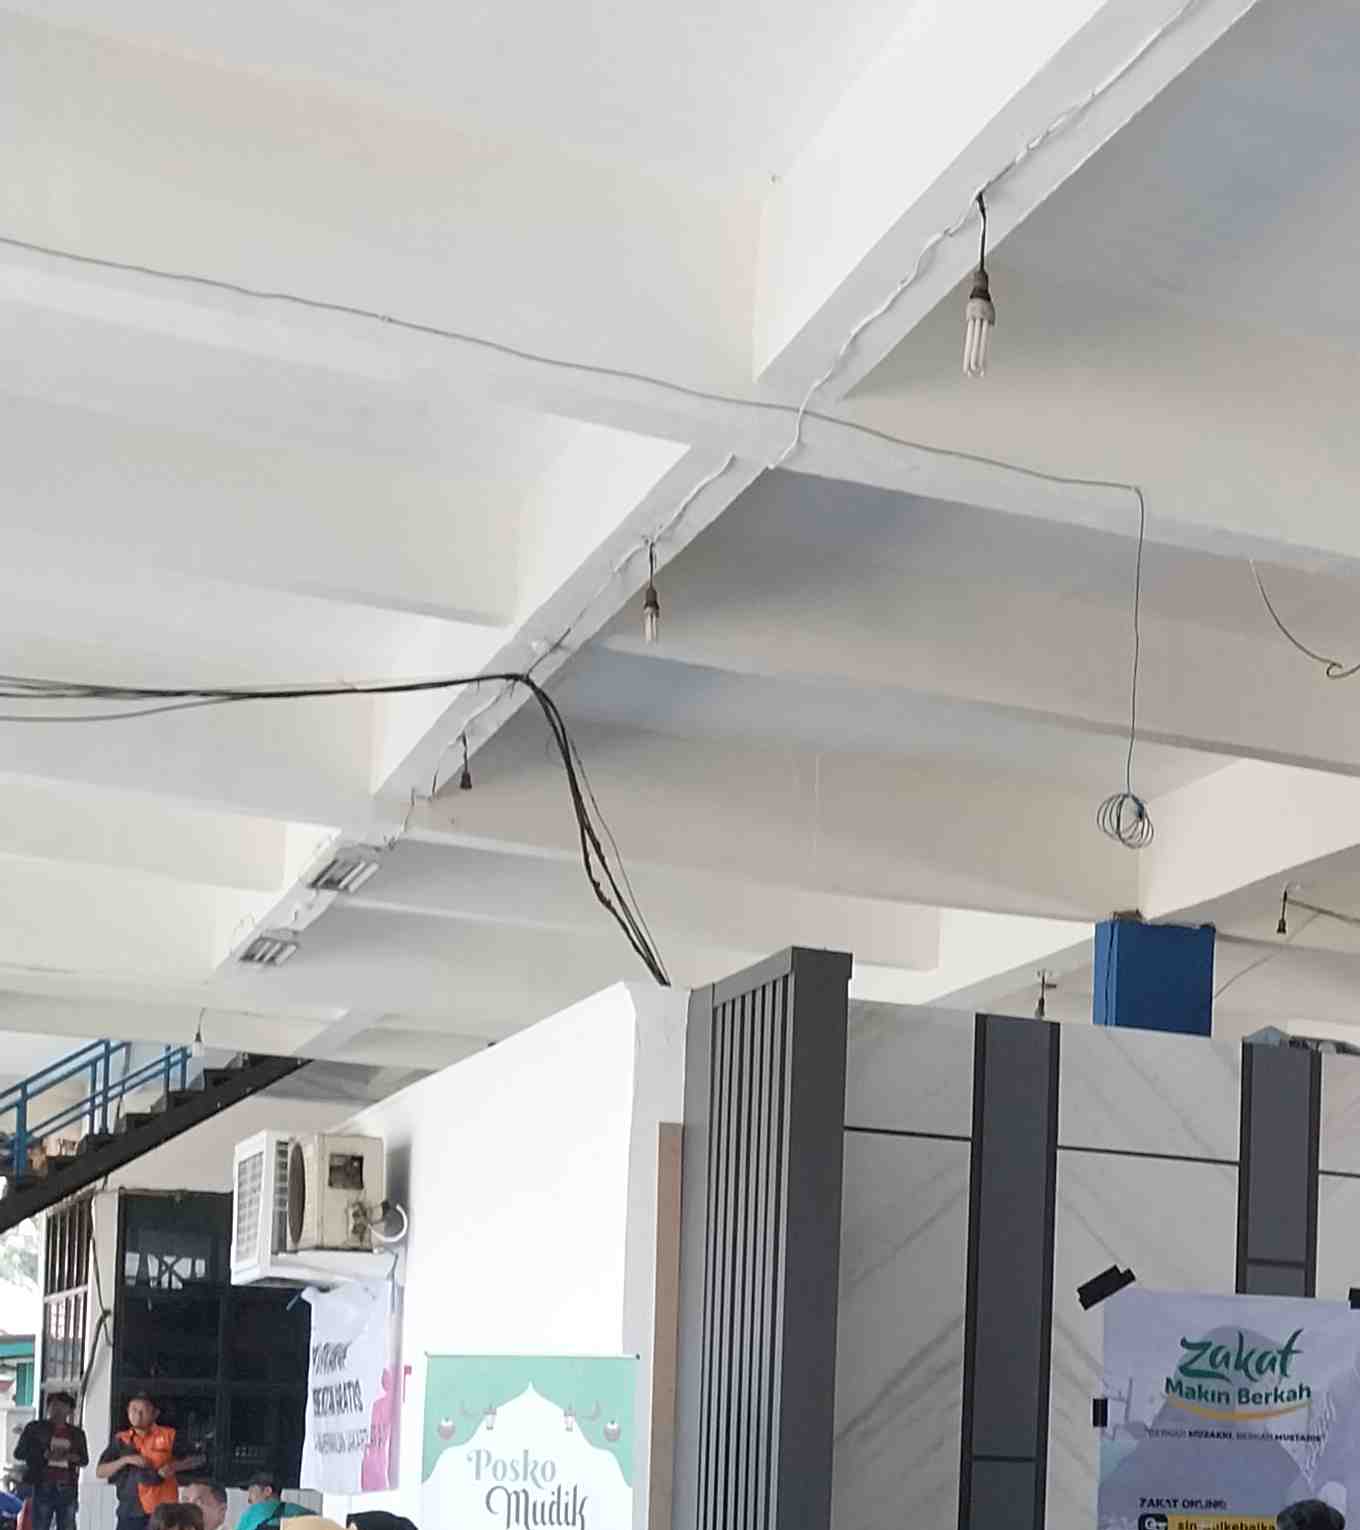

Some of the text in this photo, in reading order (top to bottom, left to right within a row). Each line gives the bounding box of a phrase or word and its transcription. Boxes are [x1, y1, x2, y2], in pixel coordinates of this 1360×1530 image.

[1178, 1328, 1304, 1382] Zakat
[1165, 1377, 1312, 1406] Makin Berkah
[466, 1448, 557, 1489] Posko
